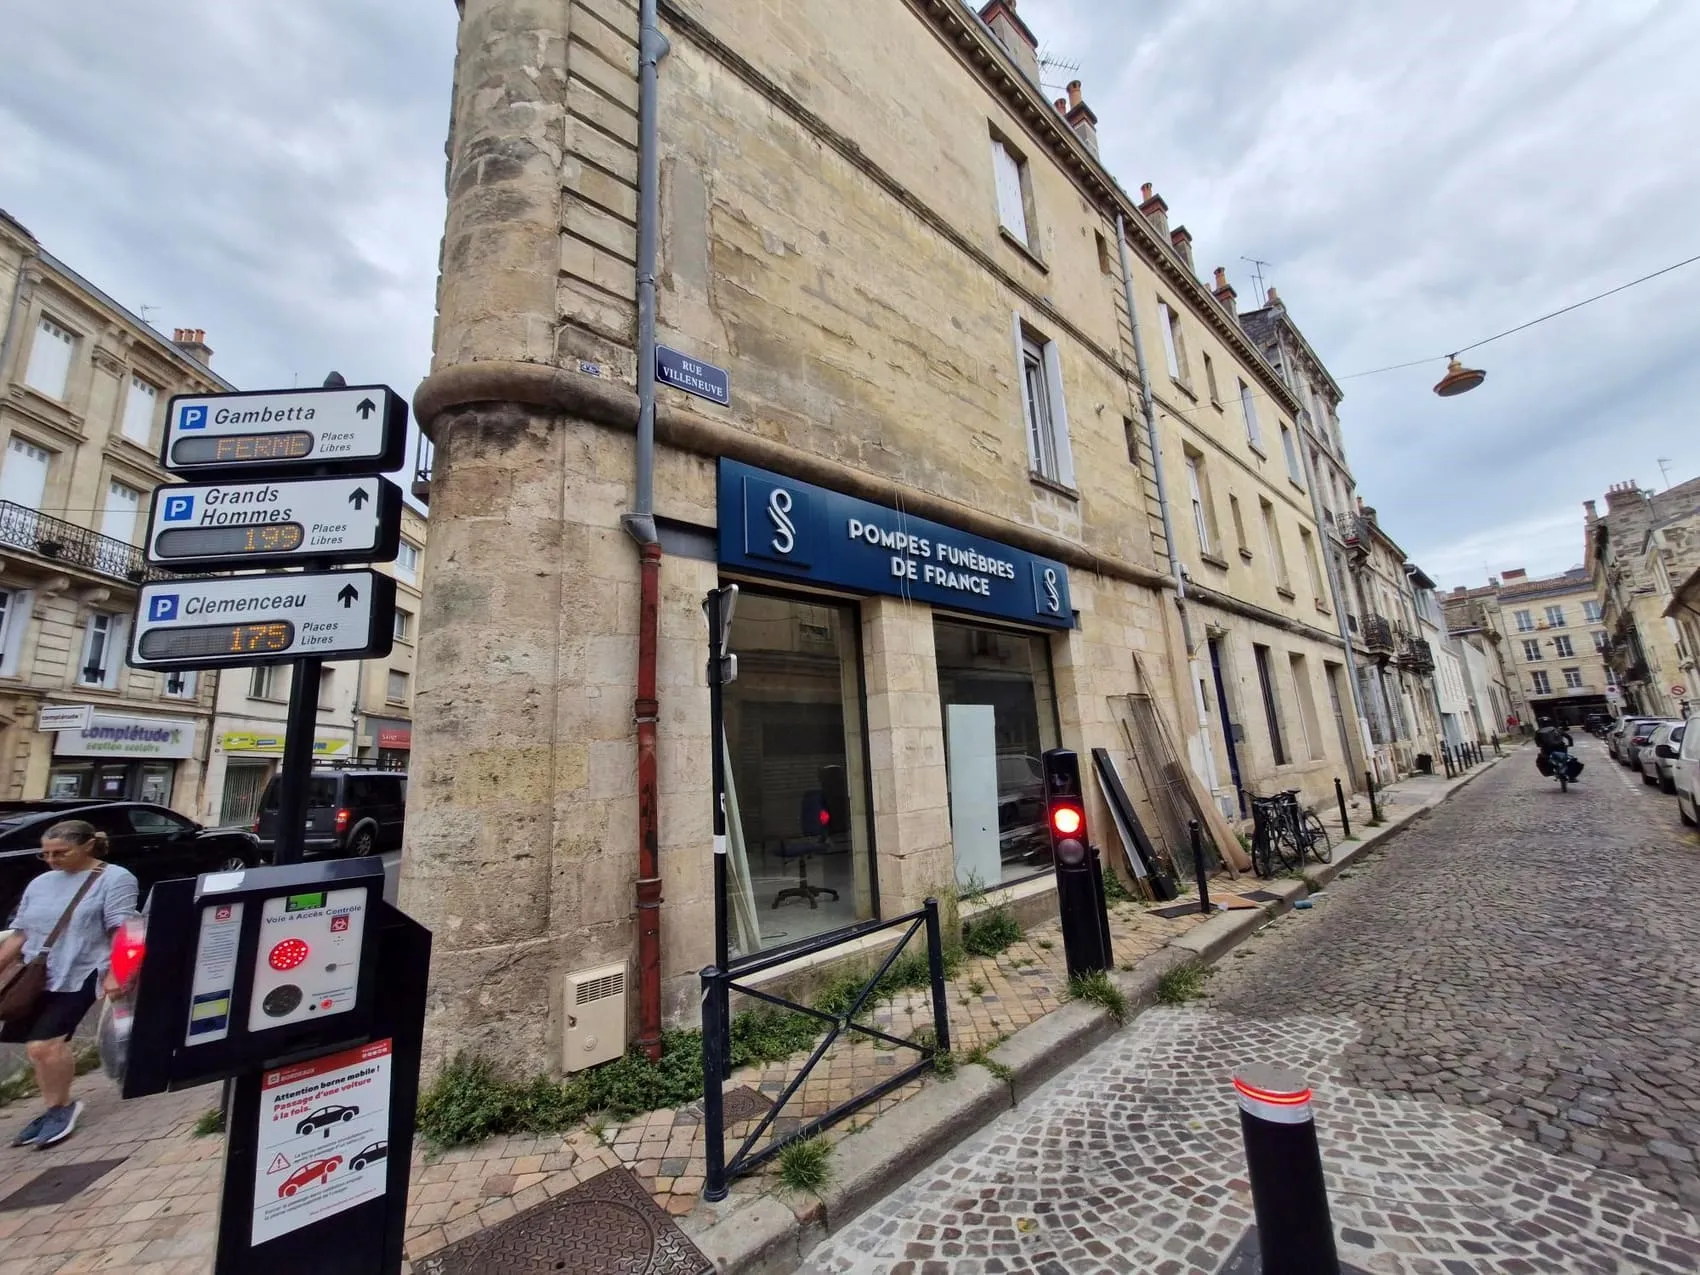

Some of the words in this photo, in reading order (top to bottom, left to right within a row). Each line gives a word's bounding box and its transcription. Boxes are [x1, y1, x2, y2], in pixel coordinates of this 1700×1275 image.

[681, 360, 703, 376] RUE
[663, 366, 724, 397] VILLENEUVE
[184, 409, 203, 427] P
[214, 406, 316, 425] Gambetta
[321, 431, 355, 441] Places
[216, 434, 309, 460] FERME
[319, 442, 352, 453] Libres
[204, 486, 279, 506] Grands
[171, 500, 189, 518] P
[200, 506, 292, 526] Hommes
[243, 526, 299, 551] 199
[311, 523, 347, 534] Places
[310, 534, 344, 546] Libres
[848, 518, 931, 558] POMPES
[936, 543, 1015, 580] FUNÈBRES
[890, 556, 917, 581] DE
[923, 564, 991, 596] FRANCE
[156, 599, 173, 618] P
[185, 593, 306, 615] Clemenceau
[302, 621, 339, 632] Places
[230, 624, 286, 651] 175
[300, 634, 334, 645] Libres
[81, 725, 170, 742] complétude
[266, 917, 286, 925] Voie
[295, 911, 323, 921] Accès
[325, 905, 362, 916] Contrôle
[273, 1095, 313, 1112] Passage
[315, 1087, 340, 1100] d'une
[341, 1077, 372, 1092] voiture
[274, 1085, 319, 1102] Attention
[320, 1076, 346, 1089] borne
[347, 1067, 375, 1081] mobile
[280, 1111, 289, 1120] la
[290, 1105, 312, 1116] fois.
